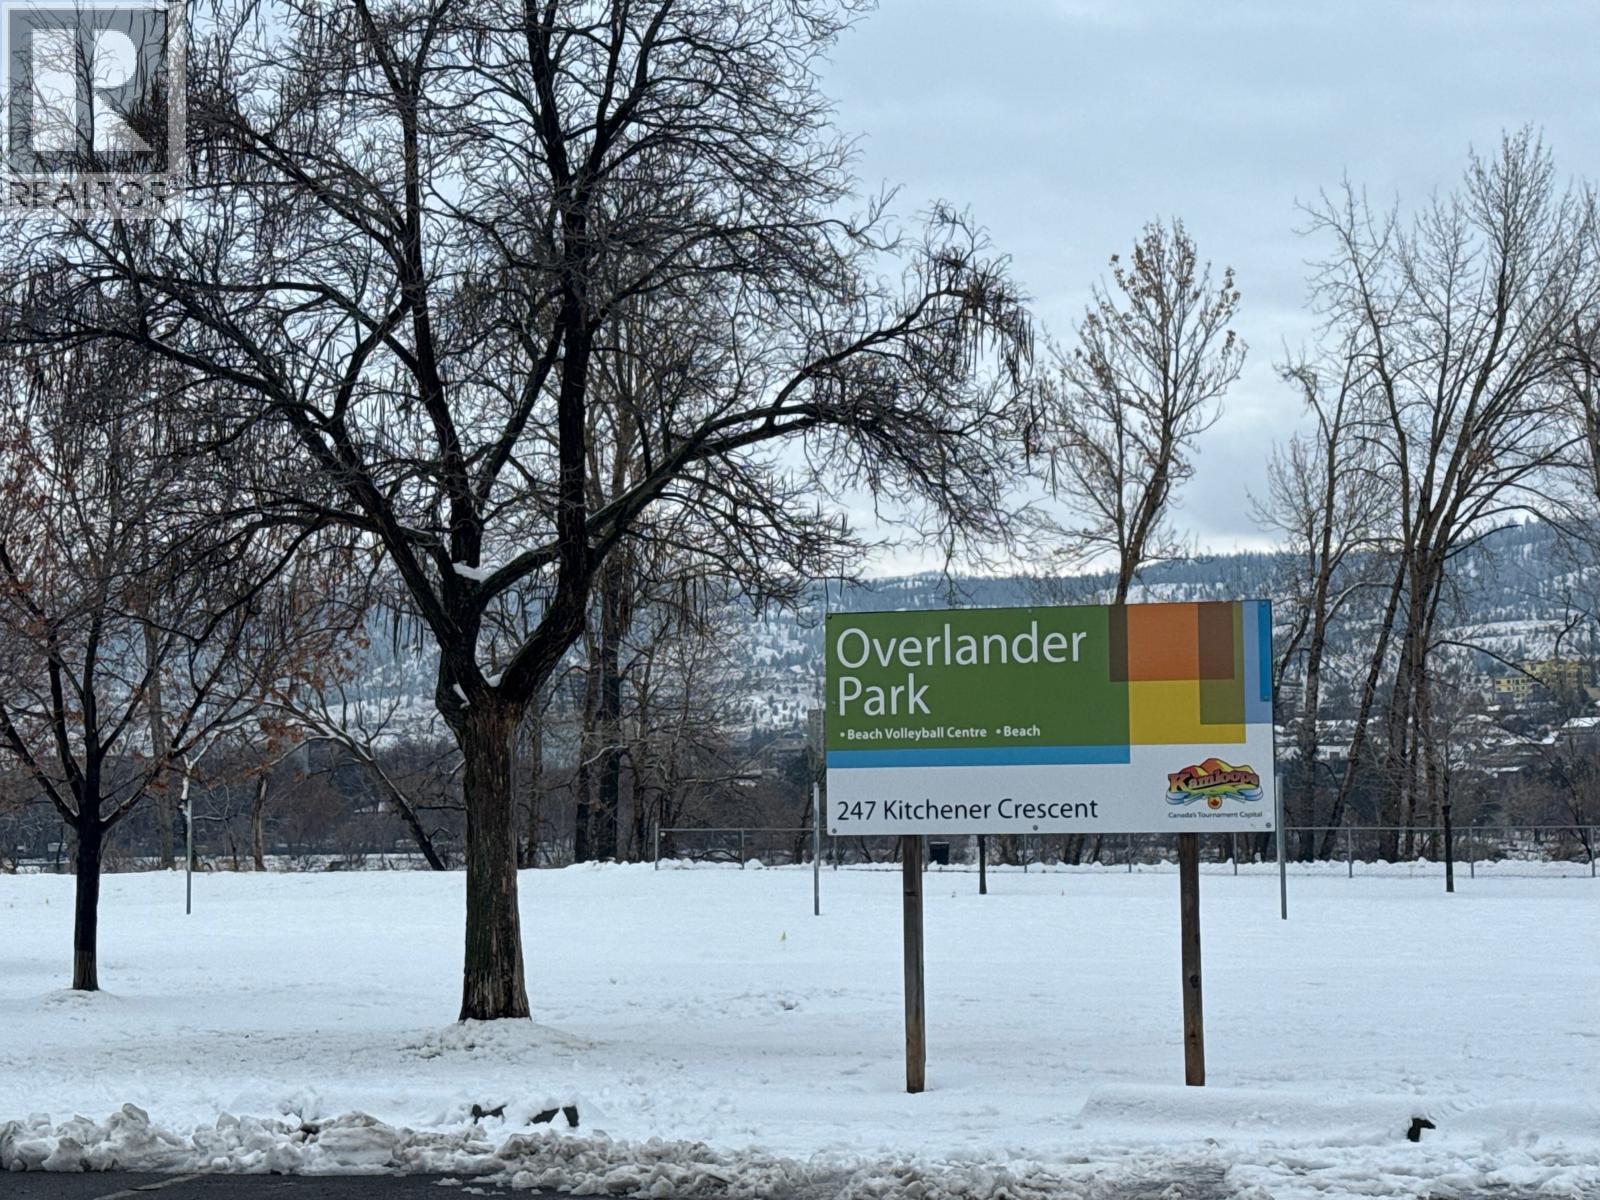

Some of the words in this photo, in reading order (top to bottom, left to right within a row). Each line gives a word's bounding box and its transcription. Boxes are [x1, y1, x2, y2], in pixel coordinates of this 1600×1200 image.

[836, 620, 1087, 669] Overlander
[838, 673, 931, 717] Park
[847, 728, 883, 740] Beach
[884, 726, 944, 742] Volleyball
[946, 727, 988, 739] Centre
[1003, 725, 1041, 737] Beach
[1167, 768, 1260, 793] Kamloops
[836, 801, 876, 820] 247
[884, 798, 992, 820] Kitchener
[997, 798, 1099, 820] Crescent
[1168, 811, 1197, 819] Canada's
[1198, 811, 1238, 819] Tournament
[1239, 811, 1263, 820] Capital
